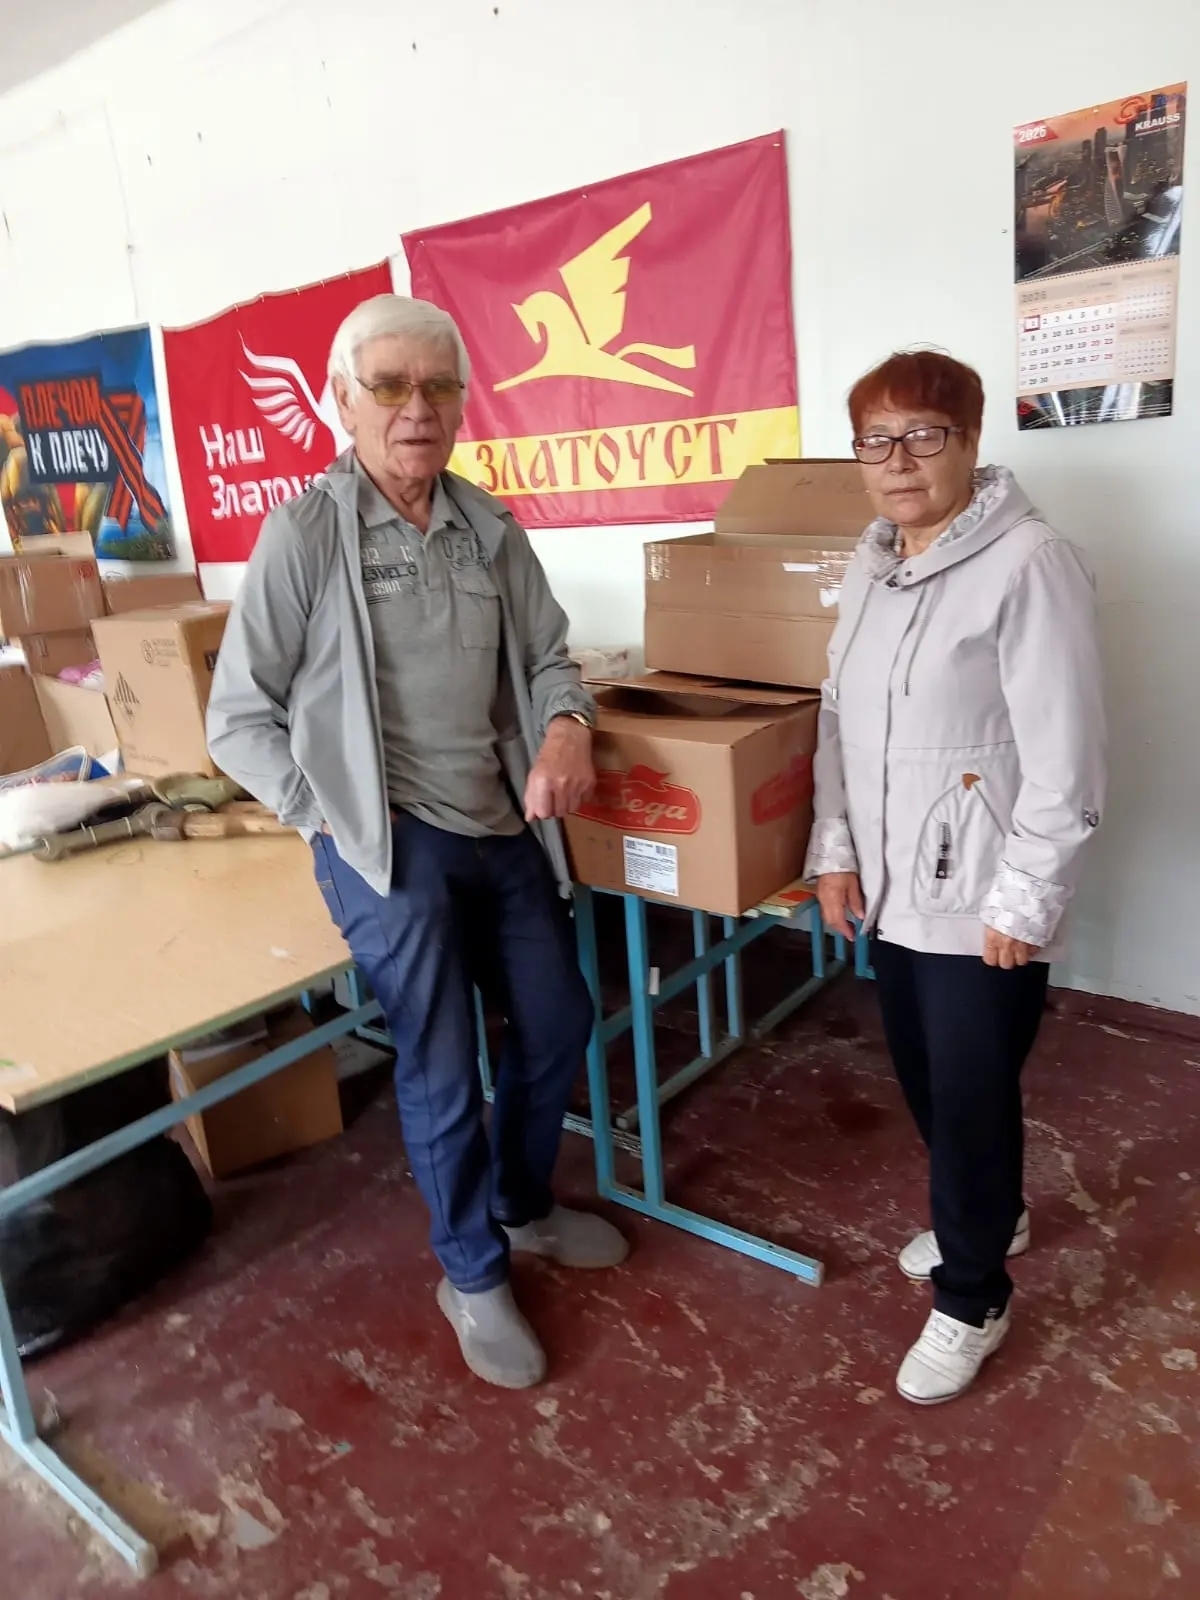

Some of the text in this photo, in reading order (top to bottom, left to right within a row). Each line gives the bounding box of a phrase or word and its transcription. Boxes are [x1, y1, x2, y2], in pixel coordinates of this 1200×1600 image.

[1135, 113, 1181, 131] KRAUSS
[20, 376, 101, 430] ПЛЕЧОМ
[28, 429, 109, 476] К ПЛЕЧУ
[199, 423, 266, 471] Наш
[476, 418, 737, 492] ЗЛАТОУСТ
